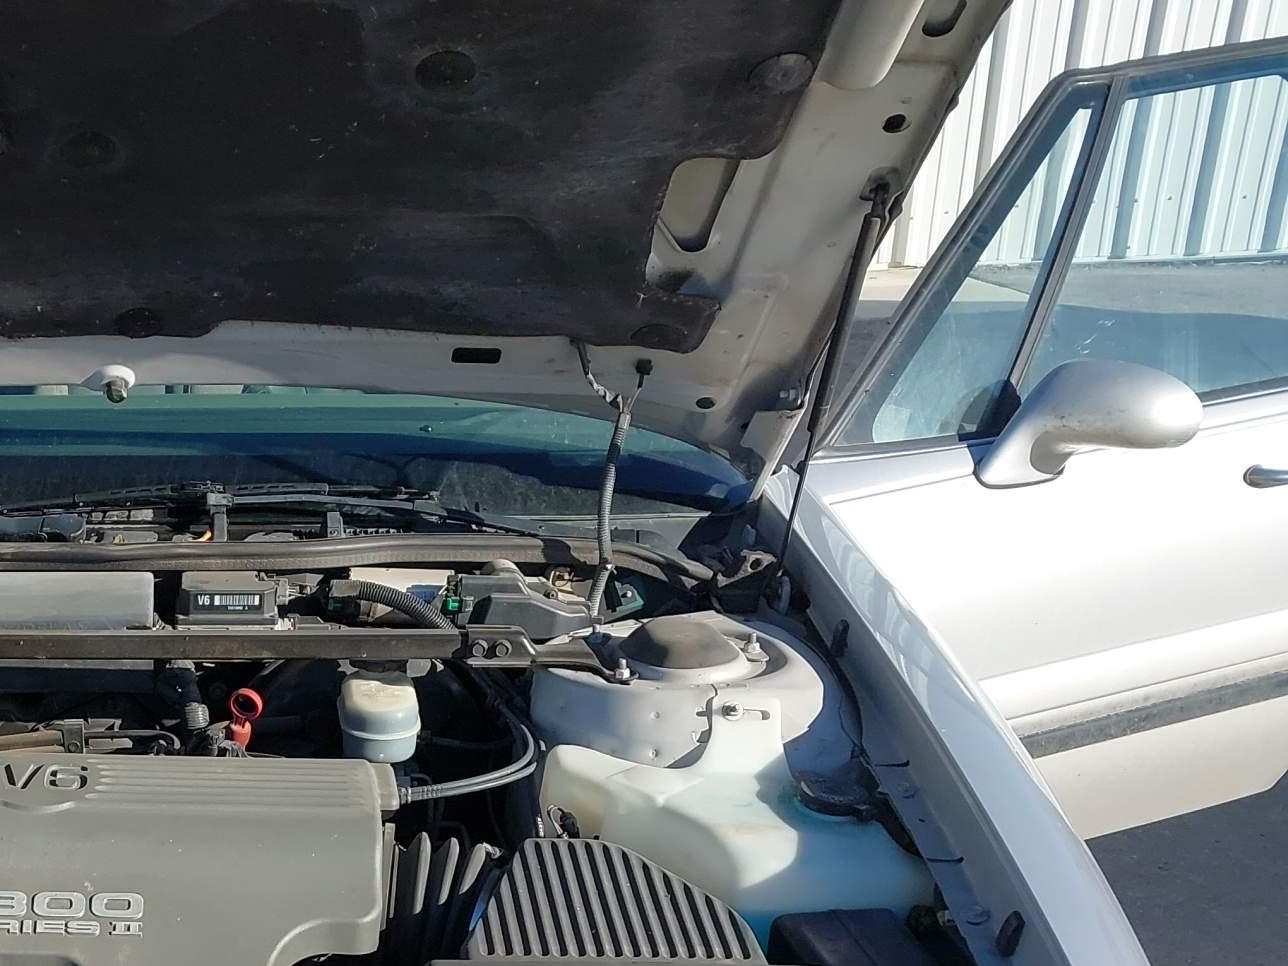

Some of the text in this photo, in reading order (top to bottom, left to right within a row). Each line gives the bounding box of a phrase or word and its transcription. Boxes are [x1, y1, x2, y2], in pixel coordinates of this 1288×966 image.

[197, 595, 210, 605] V6
[0, 764, 88, 790] V6
[108, 920, 143, 938] II
